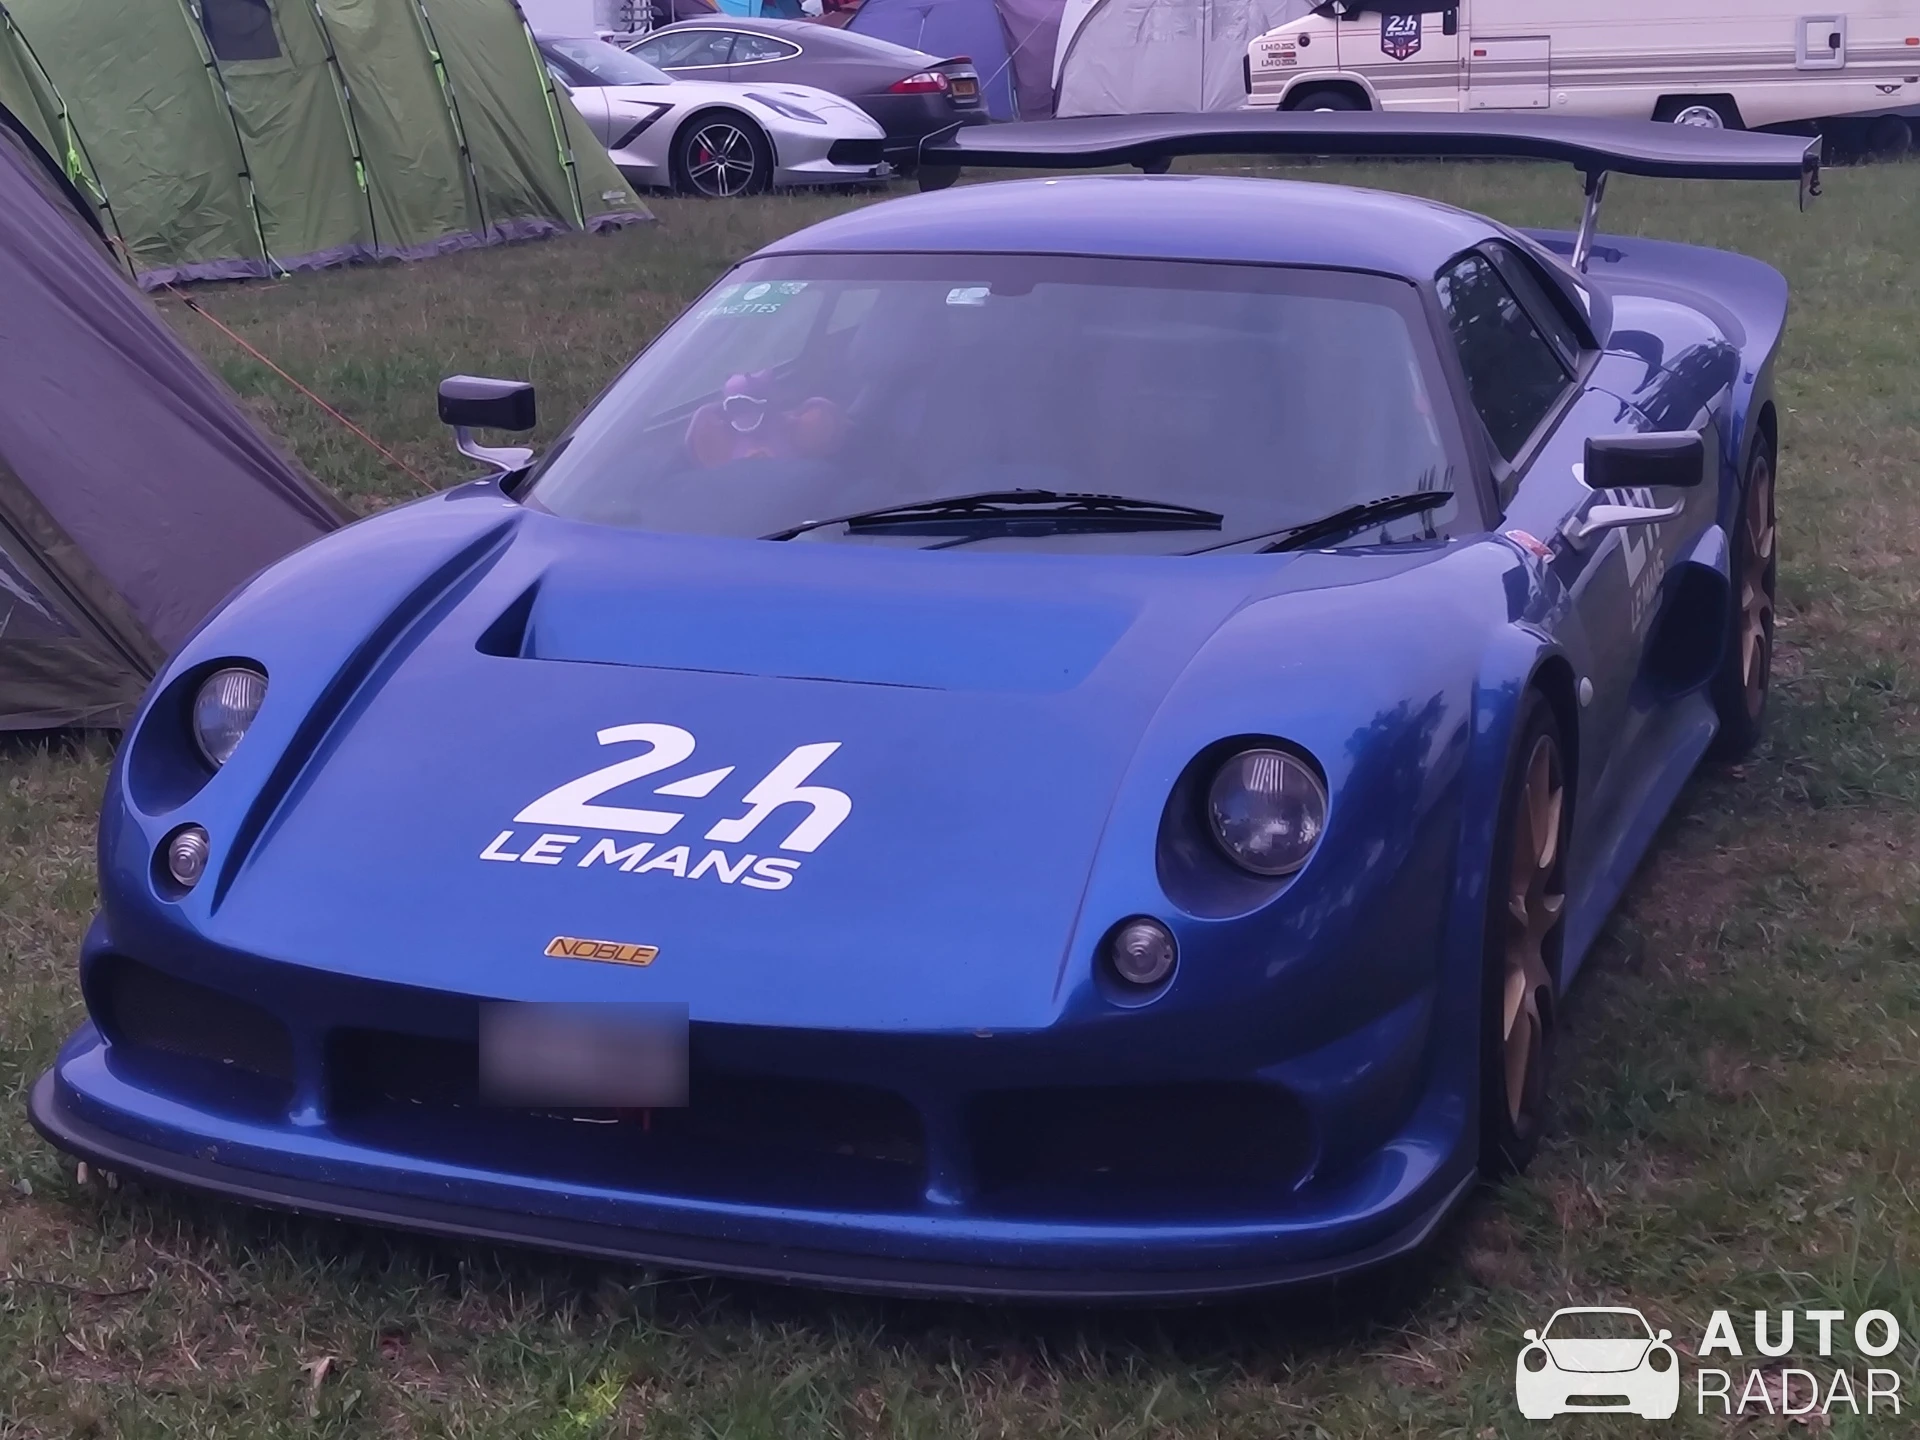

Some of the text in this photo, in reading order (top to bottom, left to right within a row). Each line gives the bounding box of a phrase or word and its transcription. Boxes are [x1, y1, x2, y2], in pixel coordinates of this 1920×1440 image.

[1386, 15, 1417, 31] 24h
[513, 722, 853, 853] 24h
[480, 830, 801, 890] LE MANS
[547, 938, 655, 963] NOBLE
